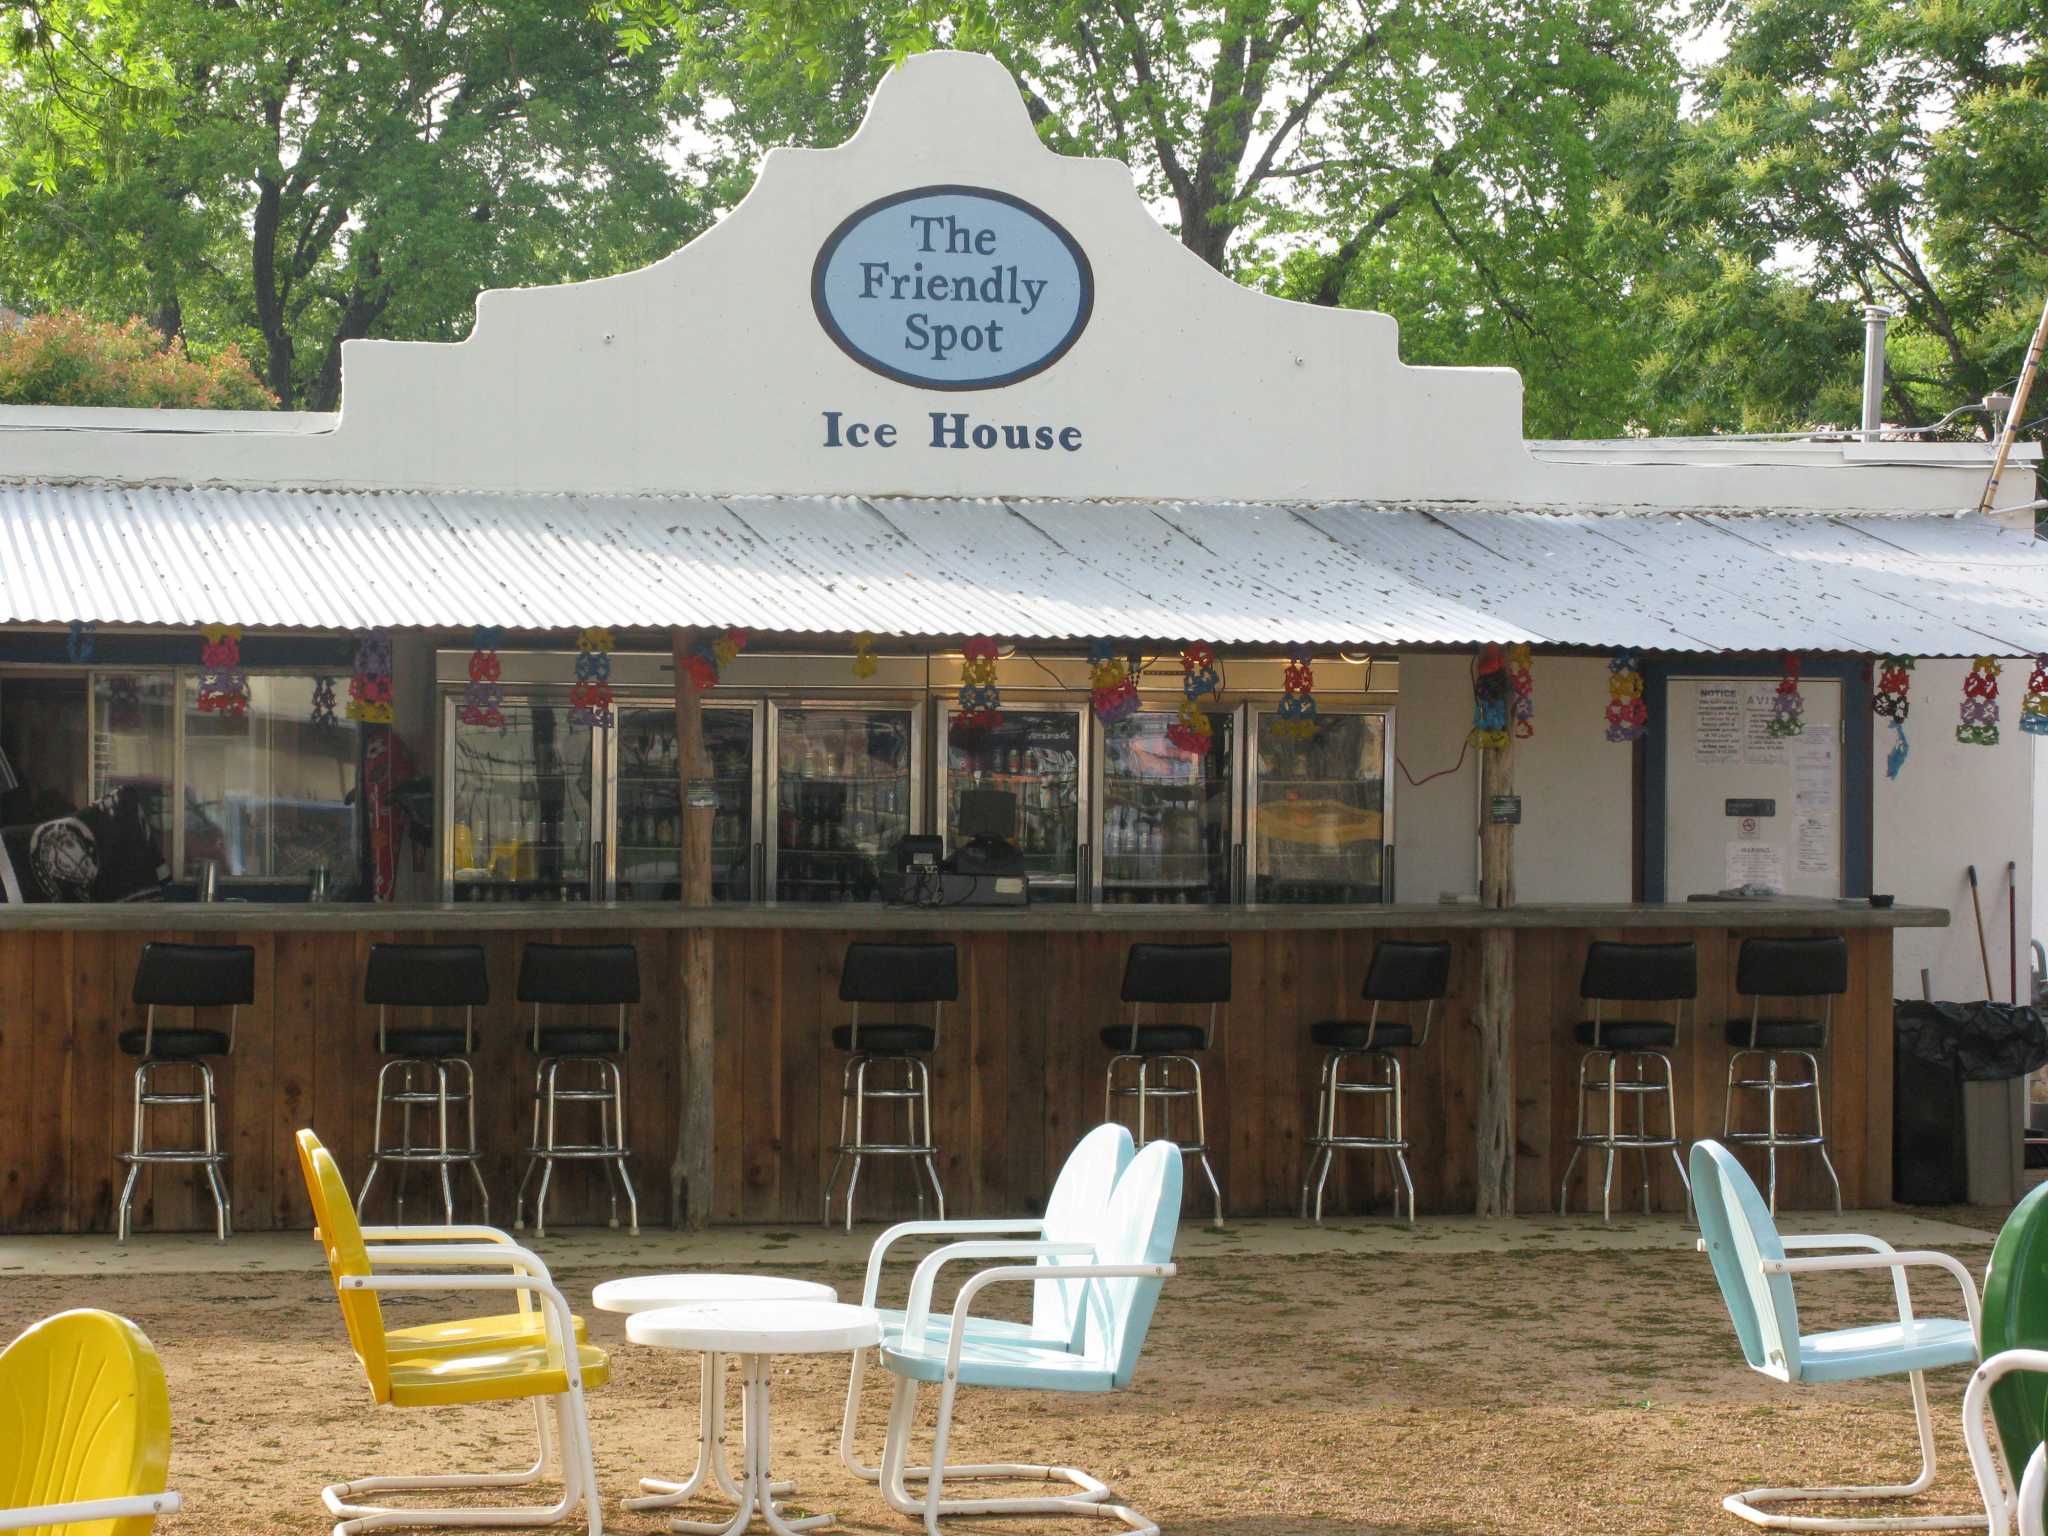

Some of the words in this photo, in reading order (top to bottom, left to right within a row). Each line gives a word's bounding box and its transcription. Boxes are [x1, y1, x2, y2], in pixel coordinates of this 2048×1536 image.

[911, 214, 996, 256] The
[858, 261, 1048, 315] Friendly
[904, 312, 1003, 361] Spot
[821, 411, 897, 448] Ice
[928, 412, 1082, 451] House
[1700, 689, 1737, 698] NOTICE
